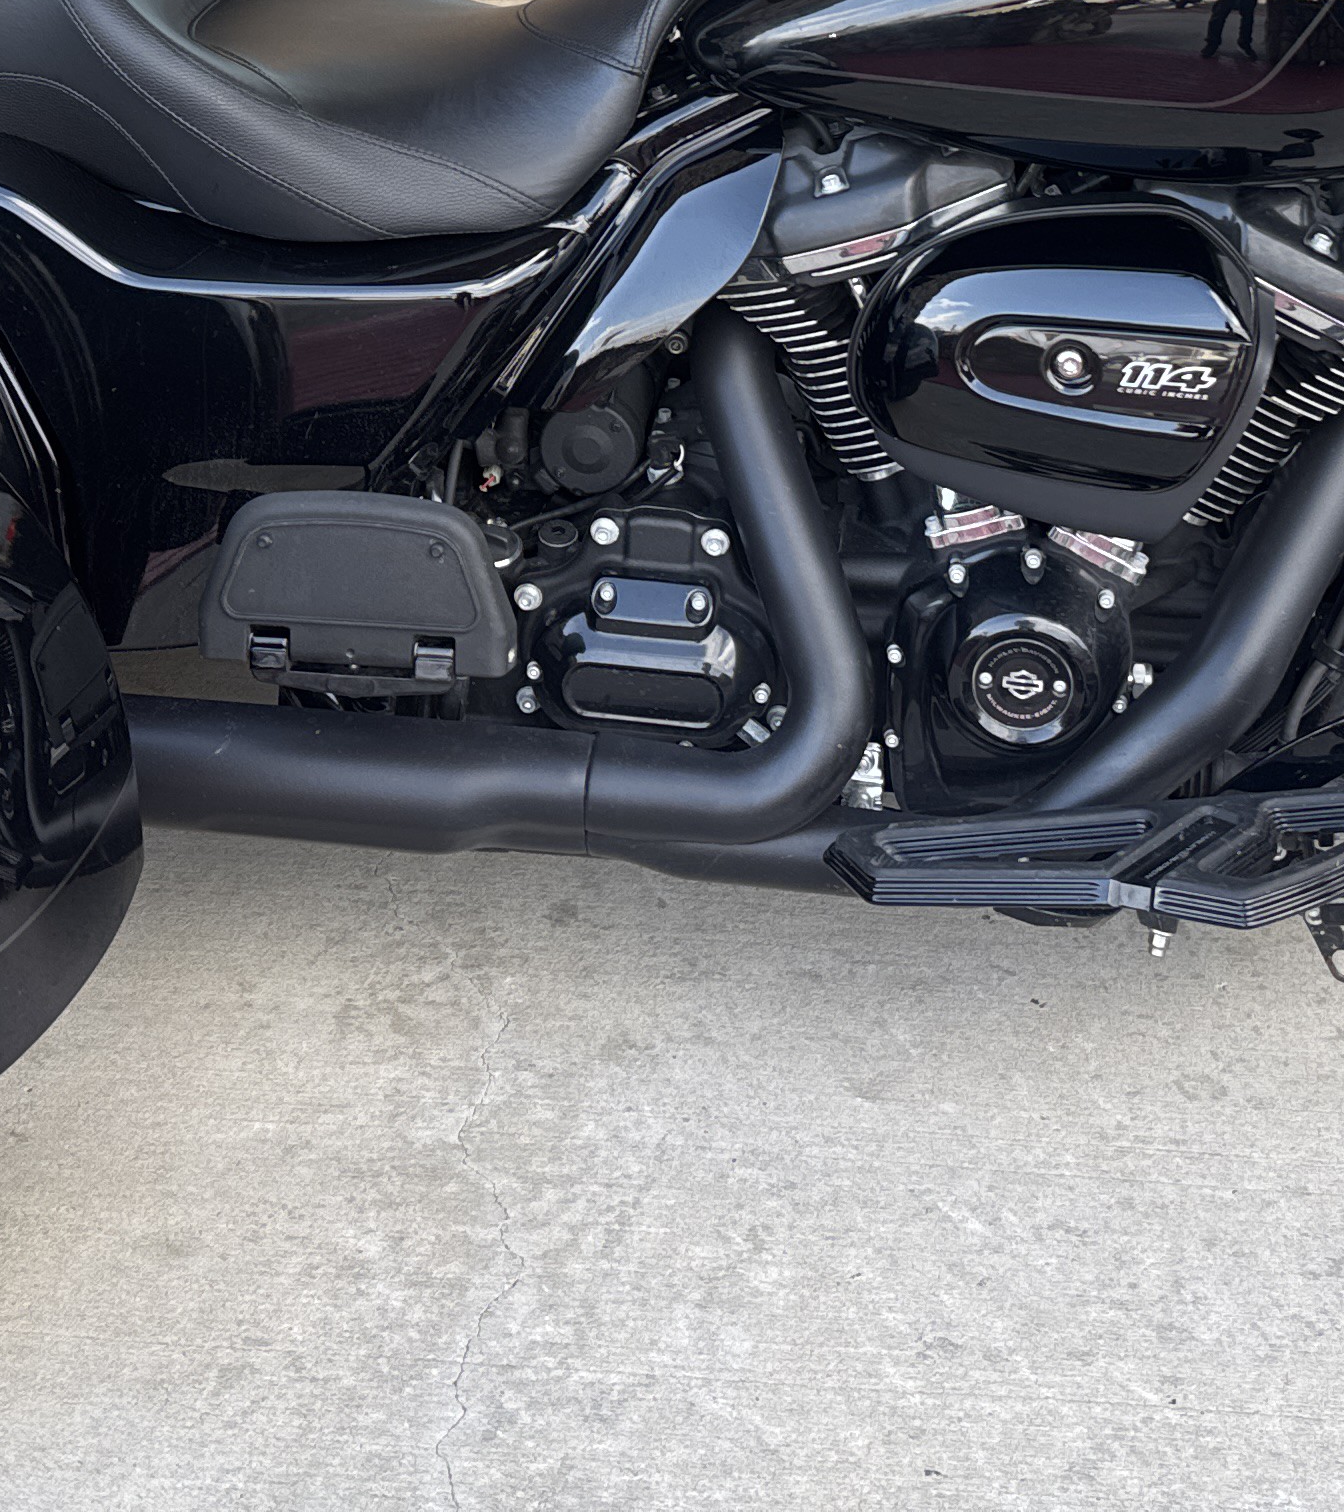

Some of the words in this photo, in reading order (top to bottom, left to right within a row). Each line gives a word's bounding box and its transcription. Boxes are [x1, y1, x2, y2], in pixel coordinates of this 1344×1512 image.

[1119, 360, 1218, 394] 114
[1116, 387, 1156, 398] CUBIC
[1161, 390, 1210, 401] INCHES
